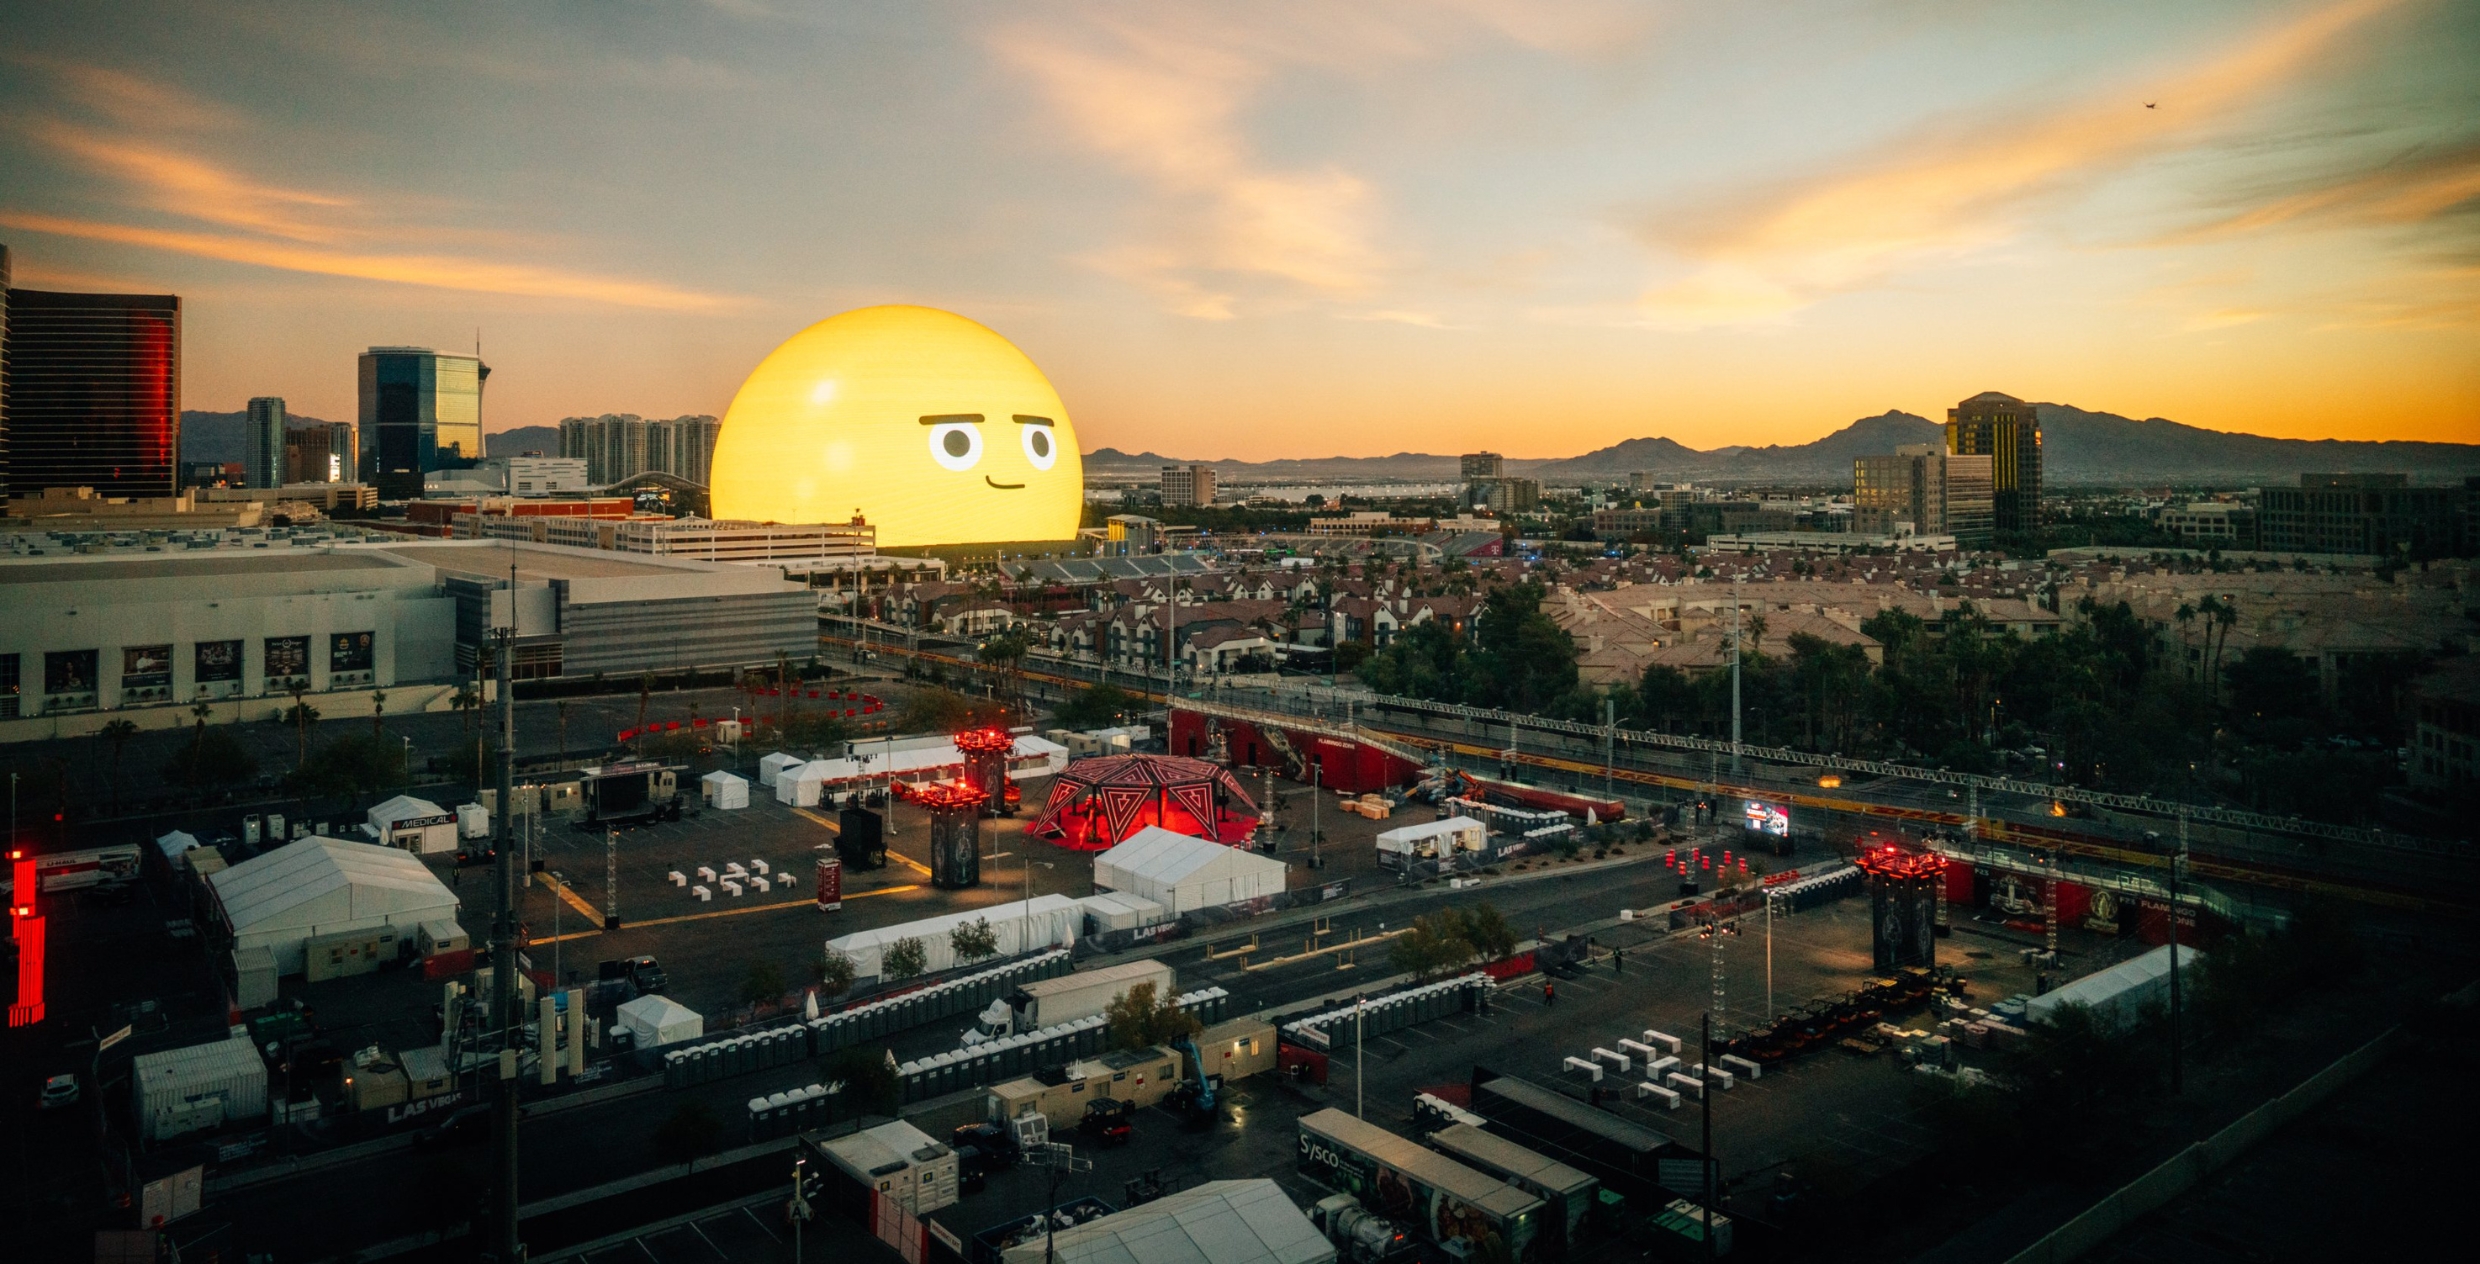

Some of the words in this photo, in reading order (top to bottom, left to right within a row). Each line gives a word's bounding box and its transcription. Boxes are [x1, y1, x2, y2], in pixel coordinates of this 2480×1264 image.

[402, 816, 450, 829] MEDICAL
[2141, 900, 2196, 917] FLAMNGO
[1134, 925, 1156, 940] LAS
[387, 1100, 428, 1124] LAS
[428, 1092, 461, 1109] VEGAS
[792, 1206, 801, 1217] A
